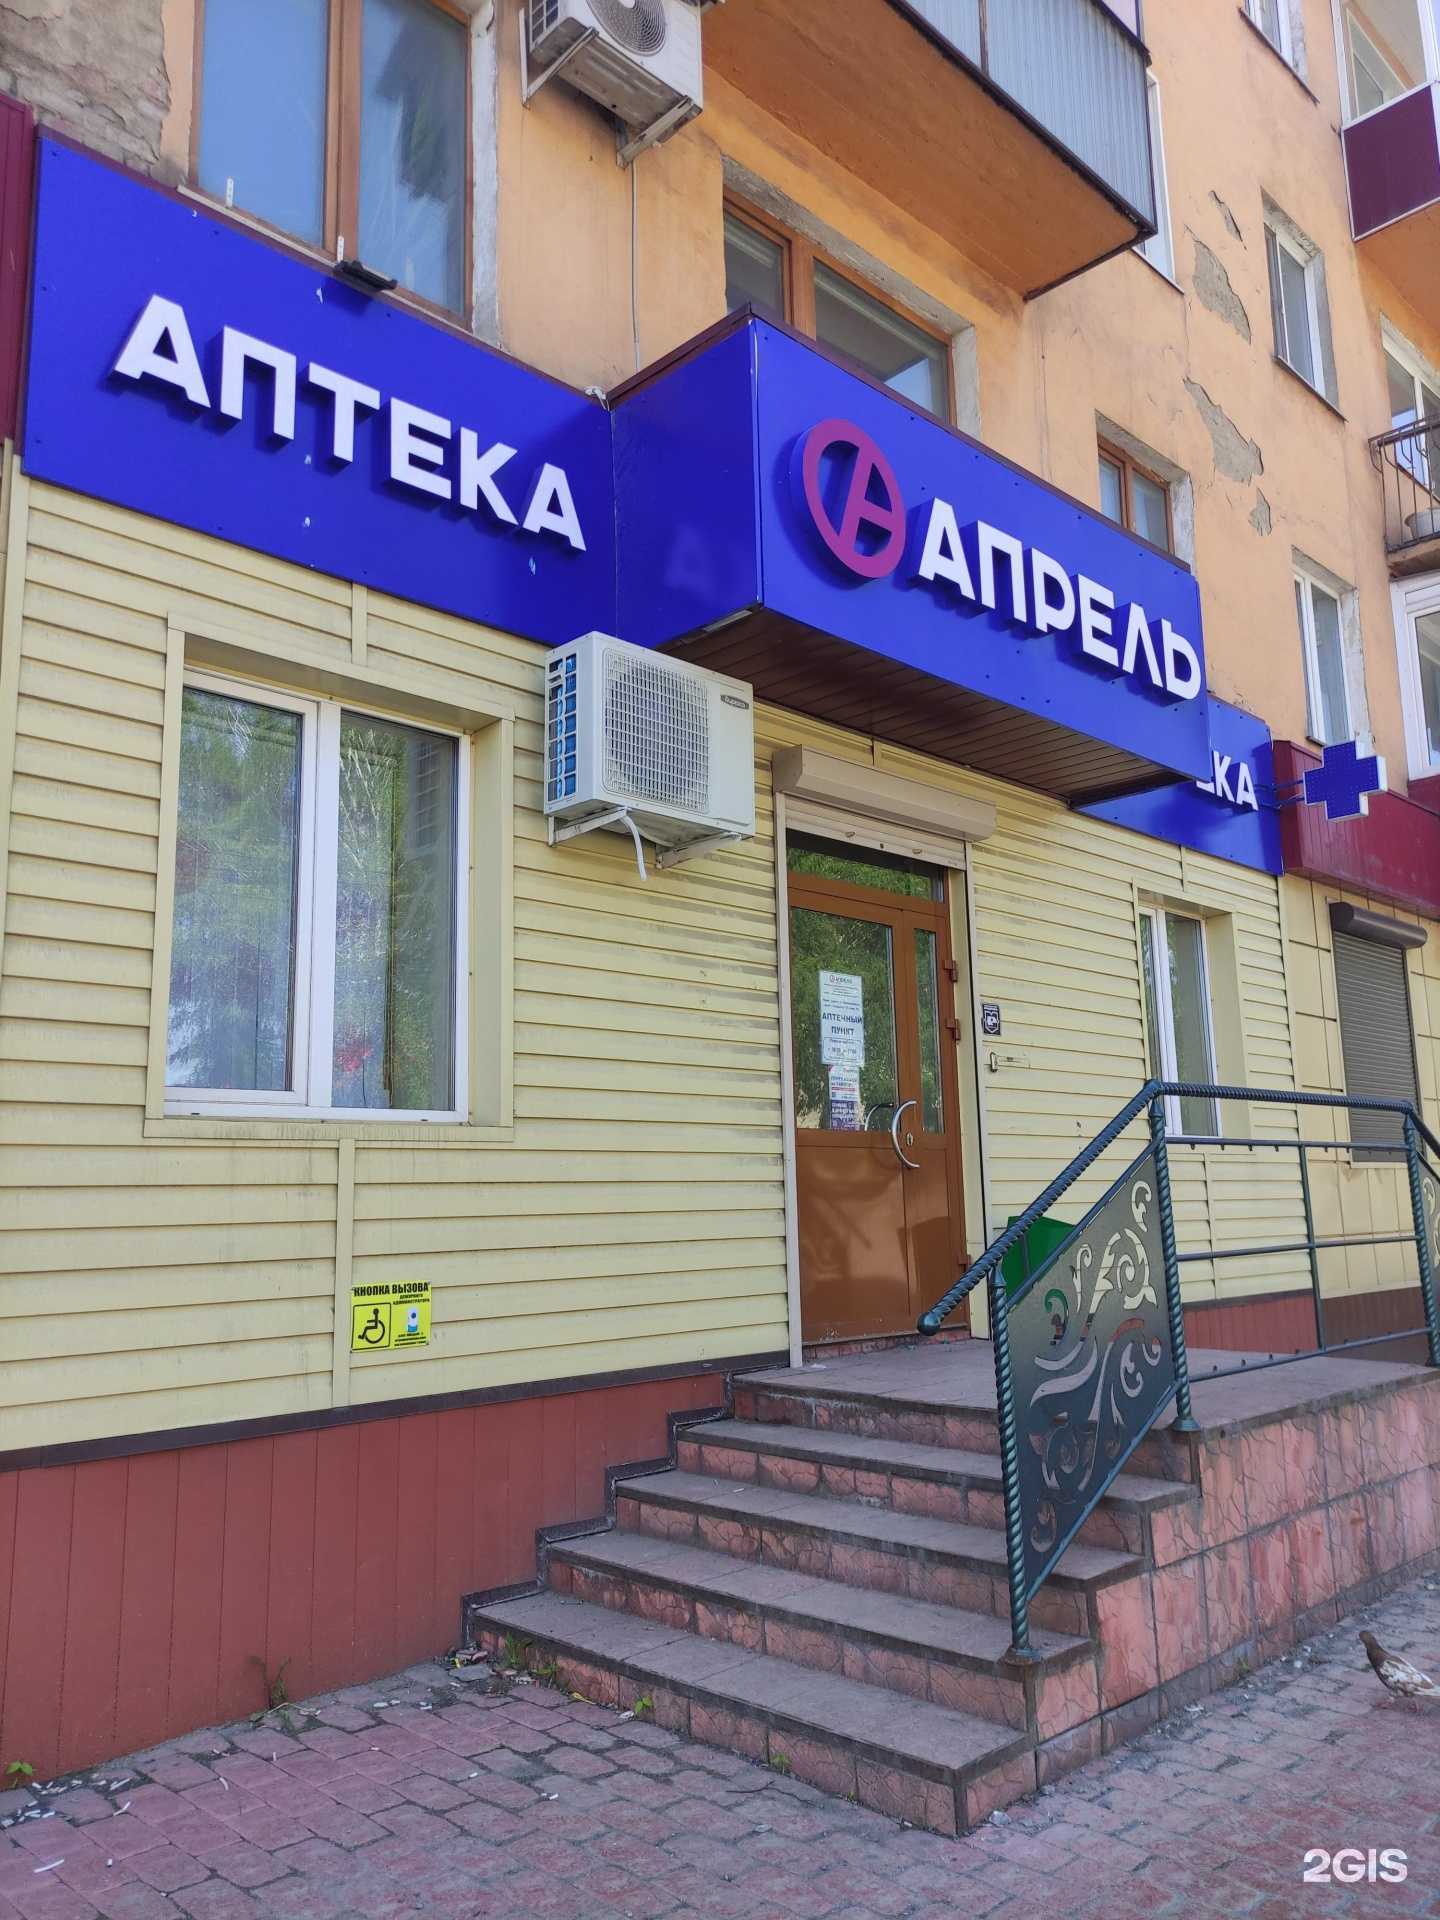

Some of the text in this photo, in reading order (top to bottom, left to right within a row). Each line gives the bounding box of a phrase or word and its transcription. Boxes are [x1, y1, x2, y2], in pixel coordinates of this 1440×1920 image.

[112, 294, 586, 552] АПТЕКА
[918, 497, 1202, 700] АПРЕЛЬ
[1196, 750, 1259, 812] КА
[353, 1285, 390, 1297] КНОПКА
[392, 1282, 429, 1294] ВЫЗОВА
